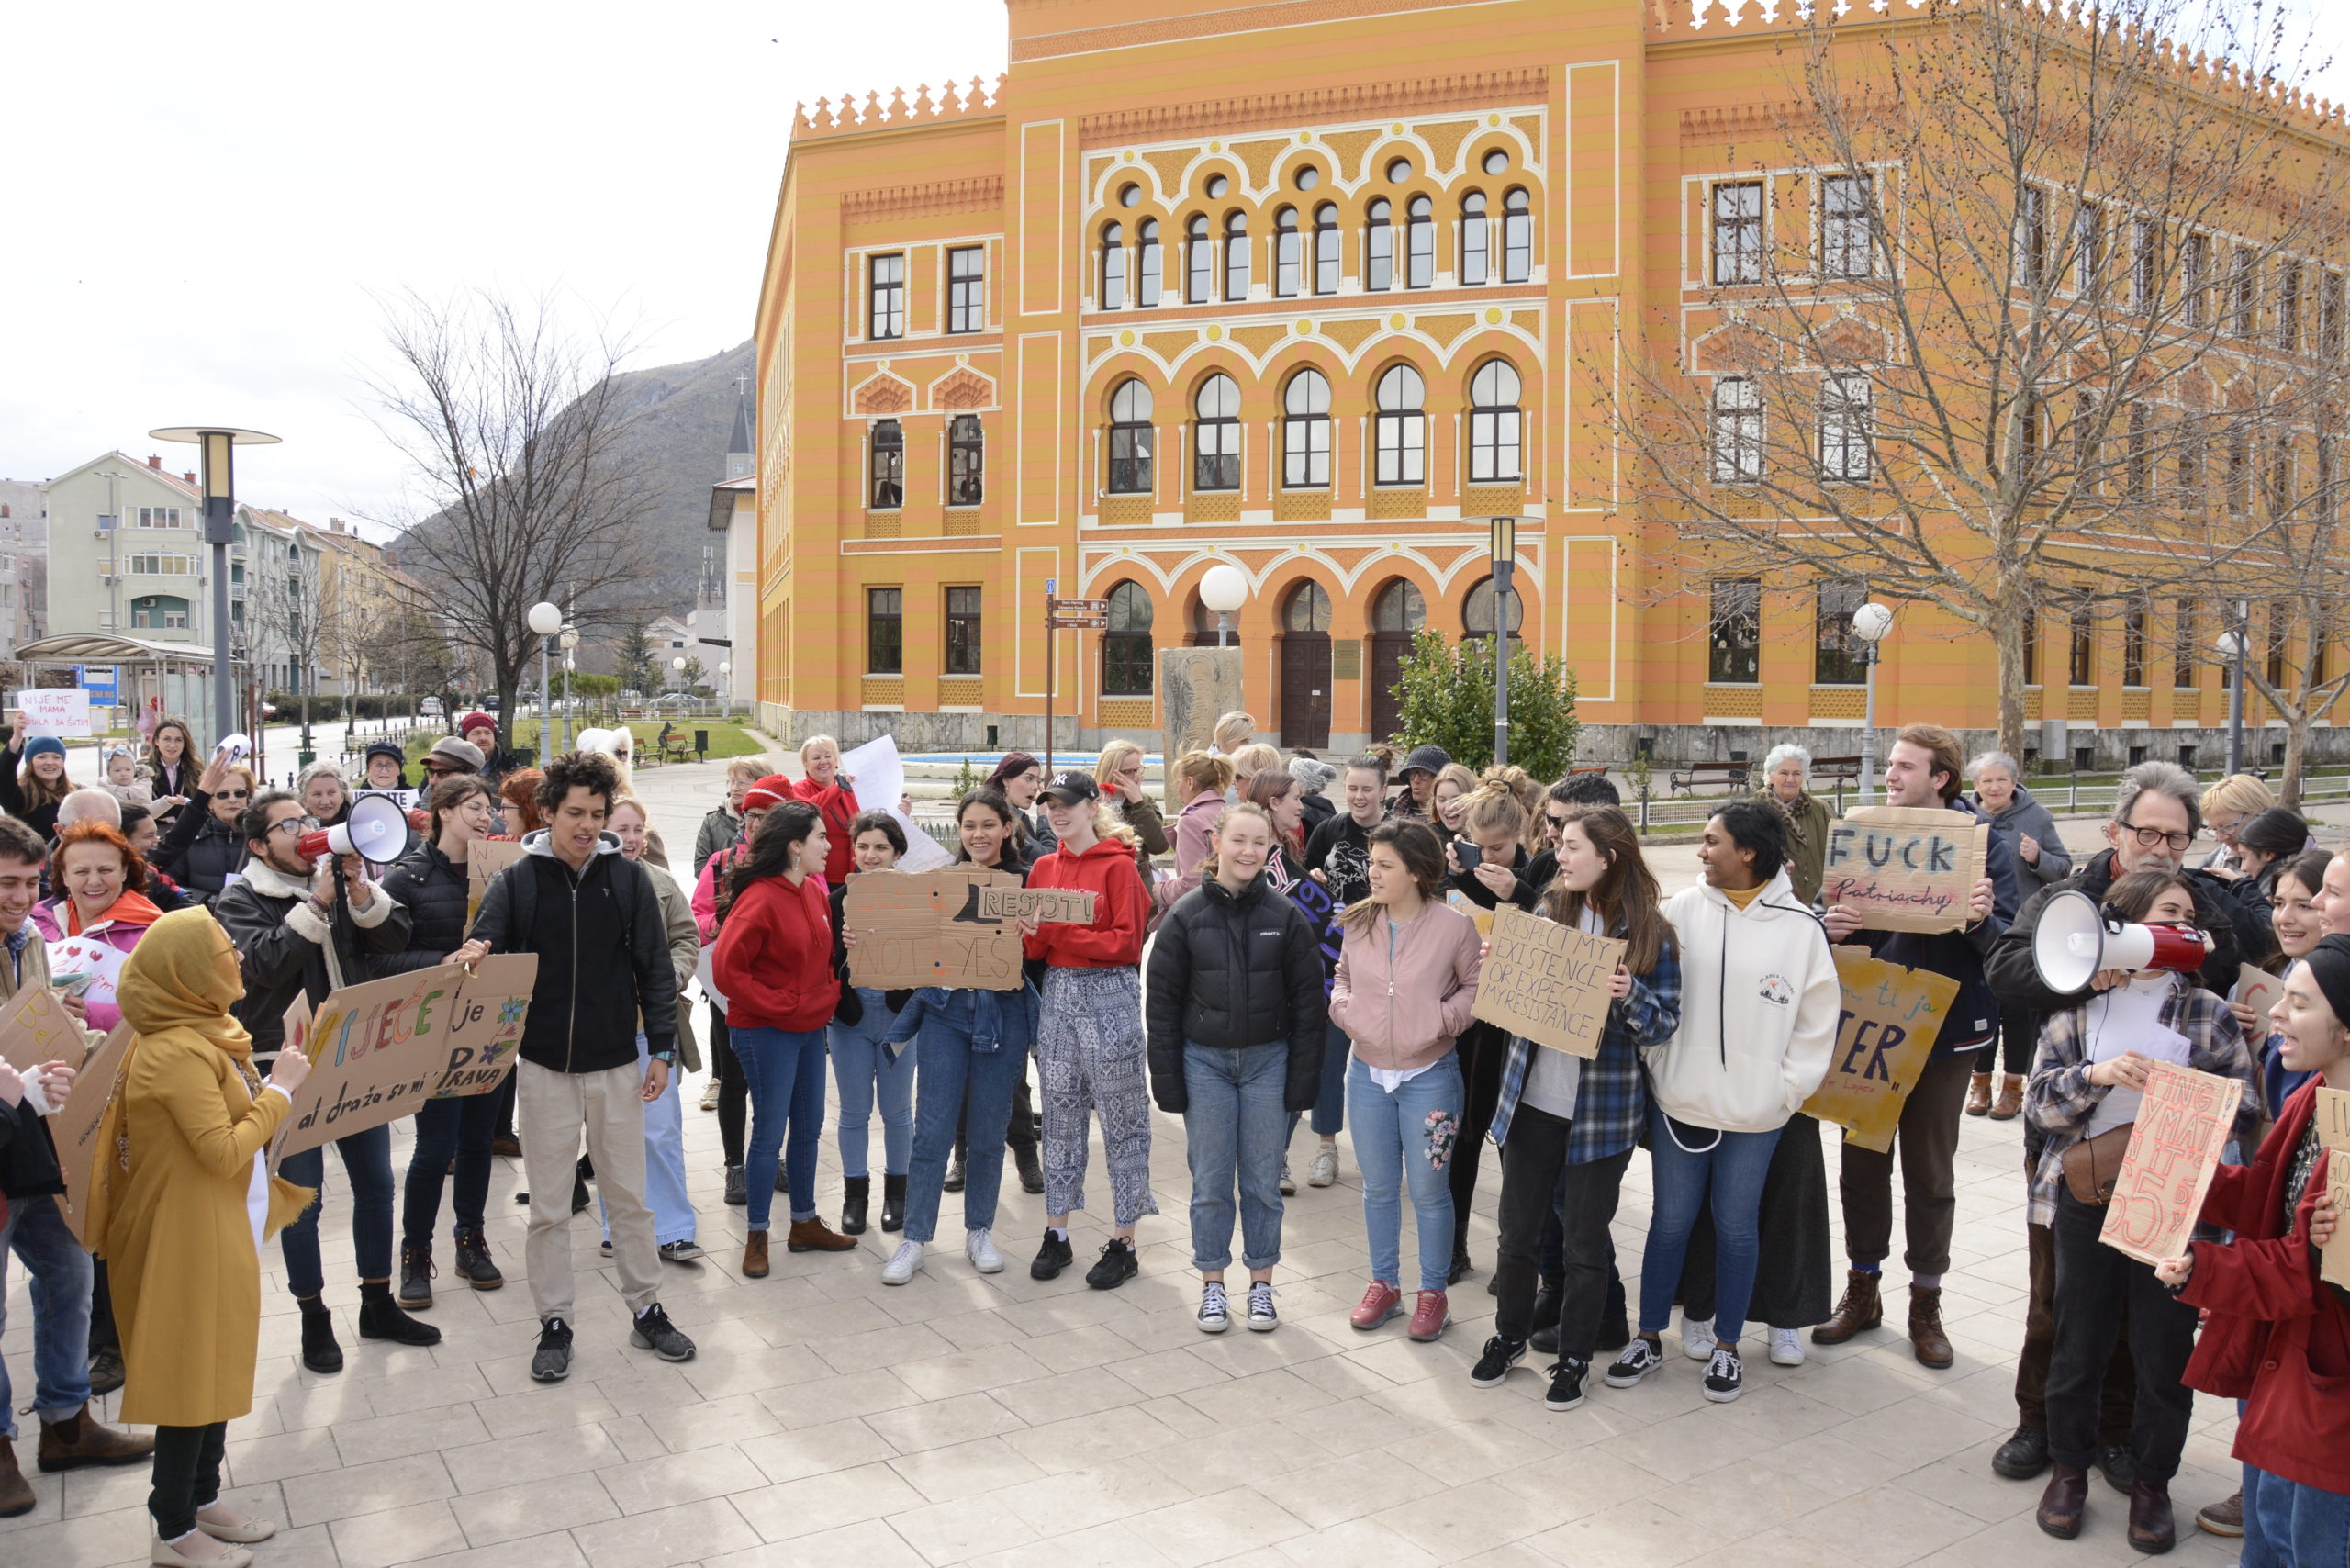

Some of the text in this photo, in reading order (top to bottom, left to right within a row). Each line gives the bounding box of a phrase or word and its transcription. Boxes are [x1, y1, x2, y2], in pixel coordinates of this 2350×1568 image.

[25, 695, 73, 705] NIJE ME
[1830, 829, 1953, 871] FUCK
[984, 891, 1091, 921] RESIST!
[1833, 878, 1952, 915] Patriarchy
[856, 937, 932, 976] NOT
[955, 936, 1010, 979] YES
[1503, 913, 1610, 961] RESPECT MY
[1495, 937, 1606, 990] EXISTENCE
[1489, 961, 1587, 1009] OR EXPECT
[451, 999, 485, 1033] je
[1903, 995, 1938, 1022] ja
[298, 1096, 322, 1130] al
[326, 1081, 382, 1125] draža
